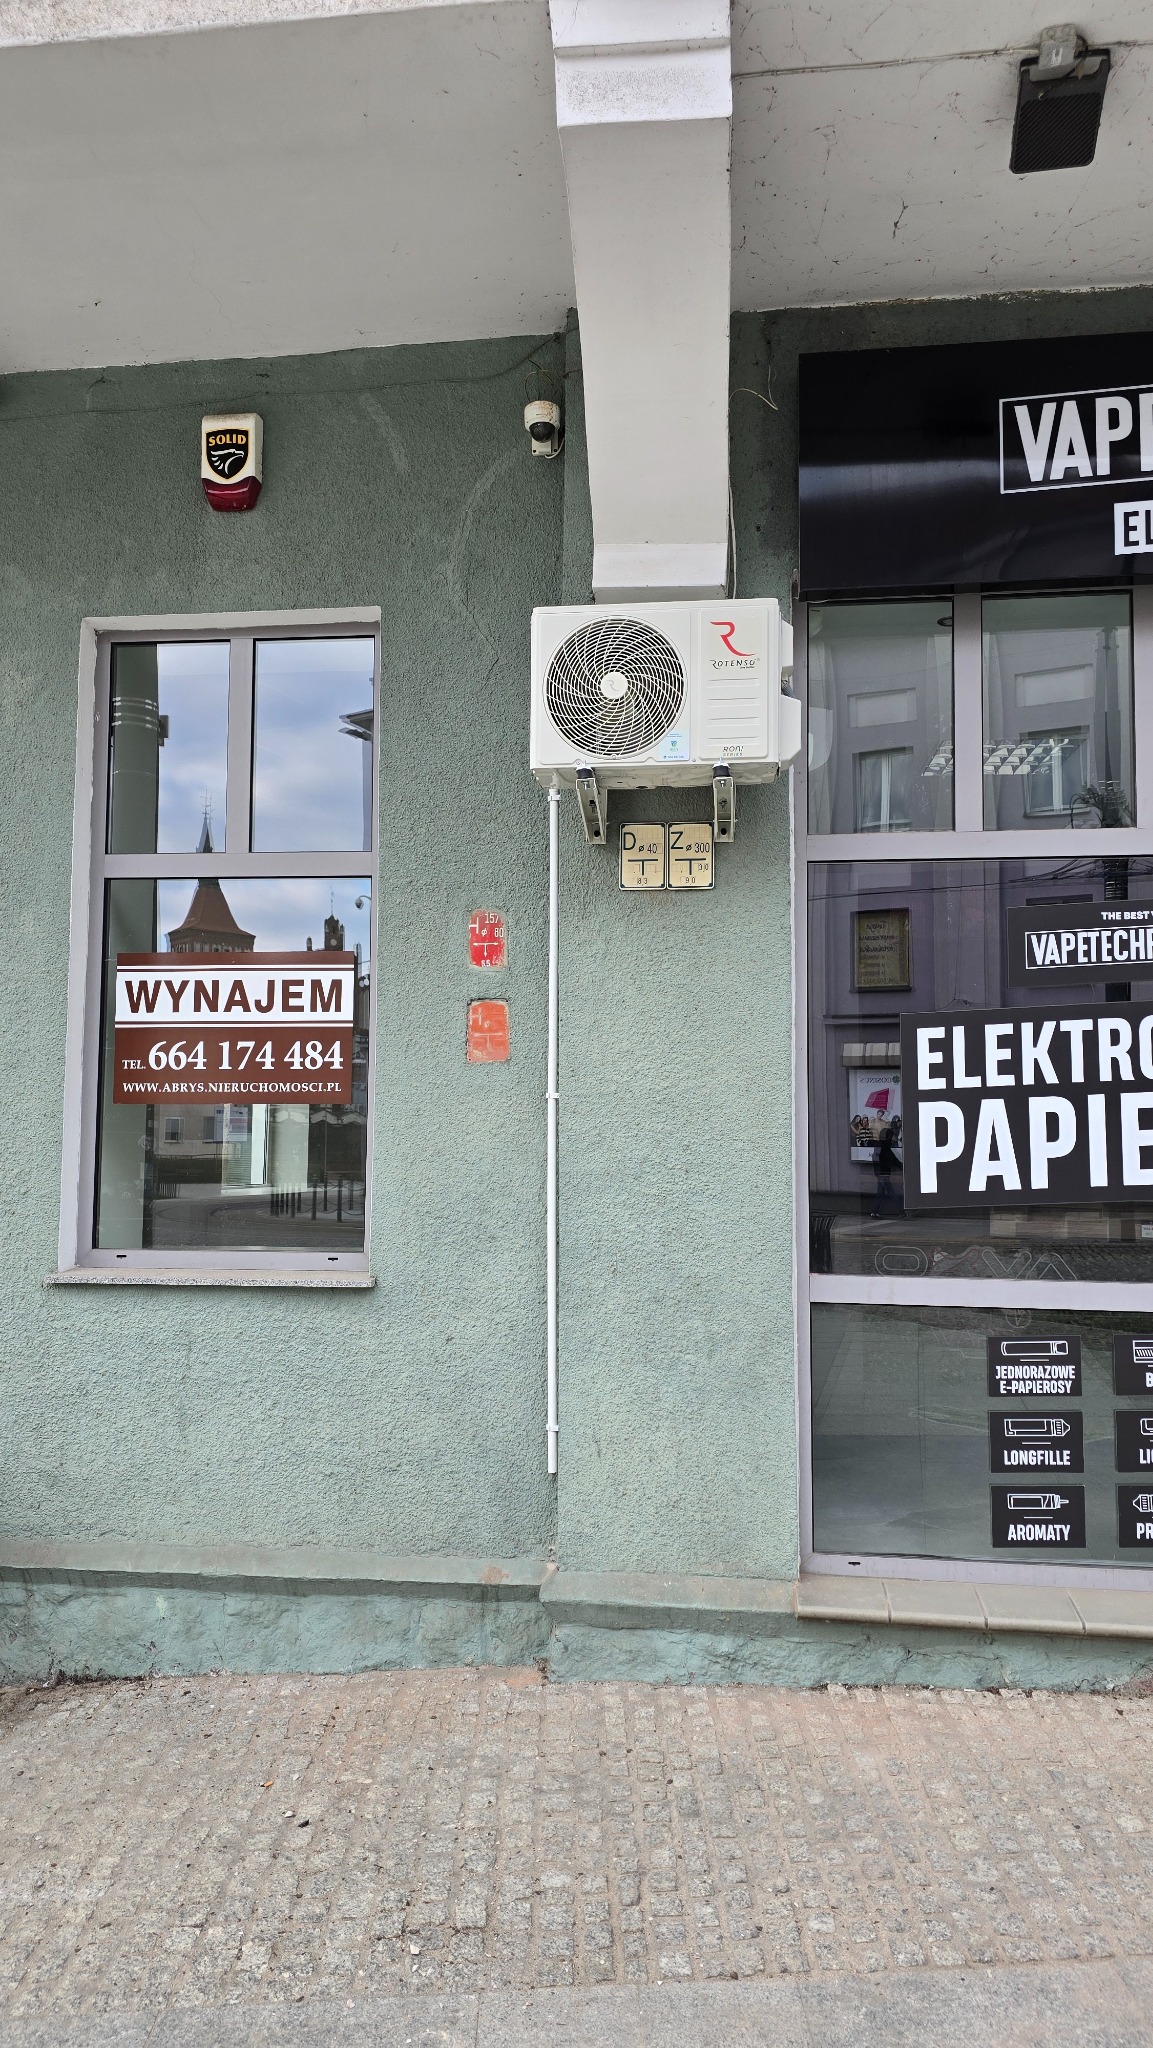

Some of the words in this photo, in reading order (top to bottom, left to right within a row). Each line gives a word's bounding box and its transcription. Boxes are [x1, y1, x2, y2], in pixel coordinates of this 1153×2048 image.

[208, 433, 247, 447] SOLID
[710, 659, 756, 670] ROTENSO
[623, 832, 636, 850] D
[670, 831, 684, 849] Z
[694, 842, 710, 853] 300
[1101, 911, 1122, 920] THE
[1123, 910, 1150, 920] BEST
[125, 979, 342, 1013] WYNAJEM
[122, 1059, 147, 1070] TEL.
[148, 1040, 207, 1071] 664
[218, 1041, 275, 1071] 174
[284, 1040, 344, 1070] 484
[122, 1082, 342, 1093] WWW.ABRYS.NIERUCHOMOSCI.PL
[918, 1092, 1153, 1194] PAPIE
[995, 1365, 1076, 1379] JEDNORAZOWE
[1000, 1380, 1073, 1394] E-PAPIEROSY
[1003, 1450, 1071, 1466] LONGFILLE
[1139, 1448, 1153, 1464] LI
[1007, 1524, 1071, 1541] AROMATY
